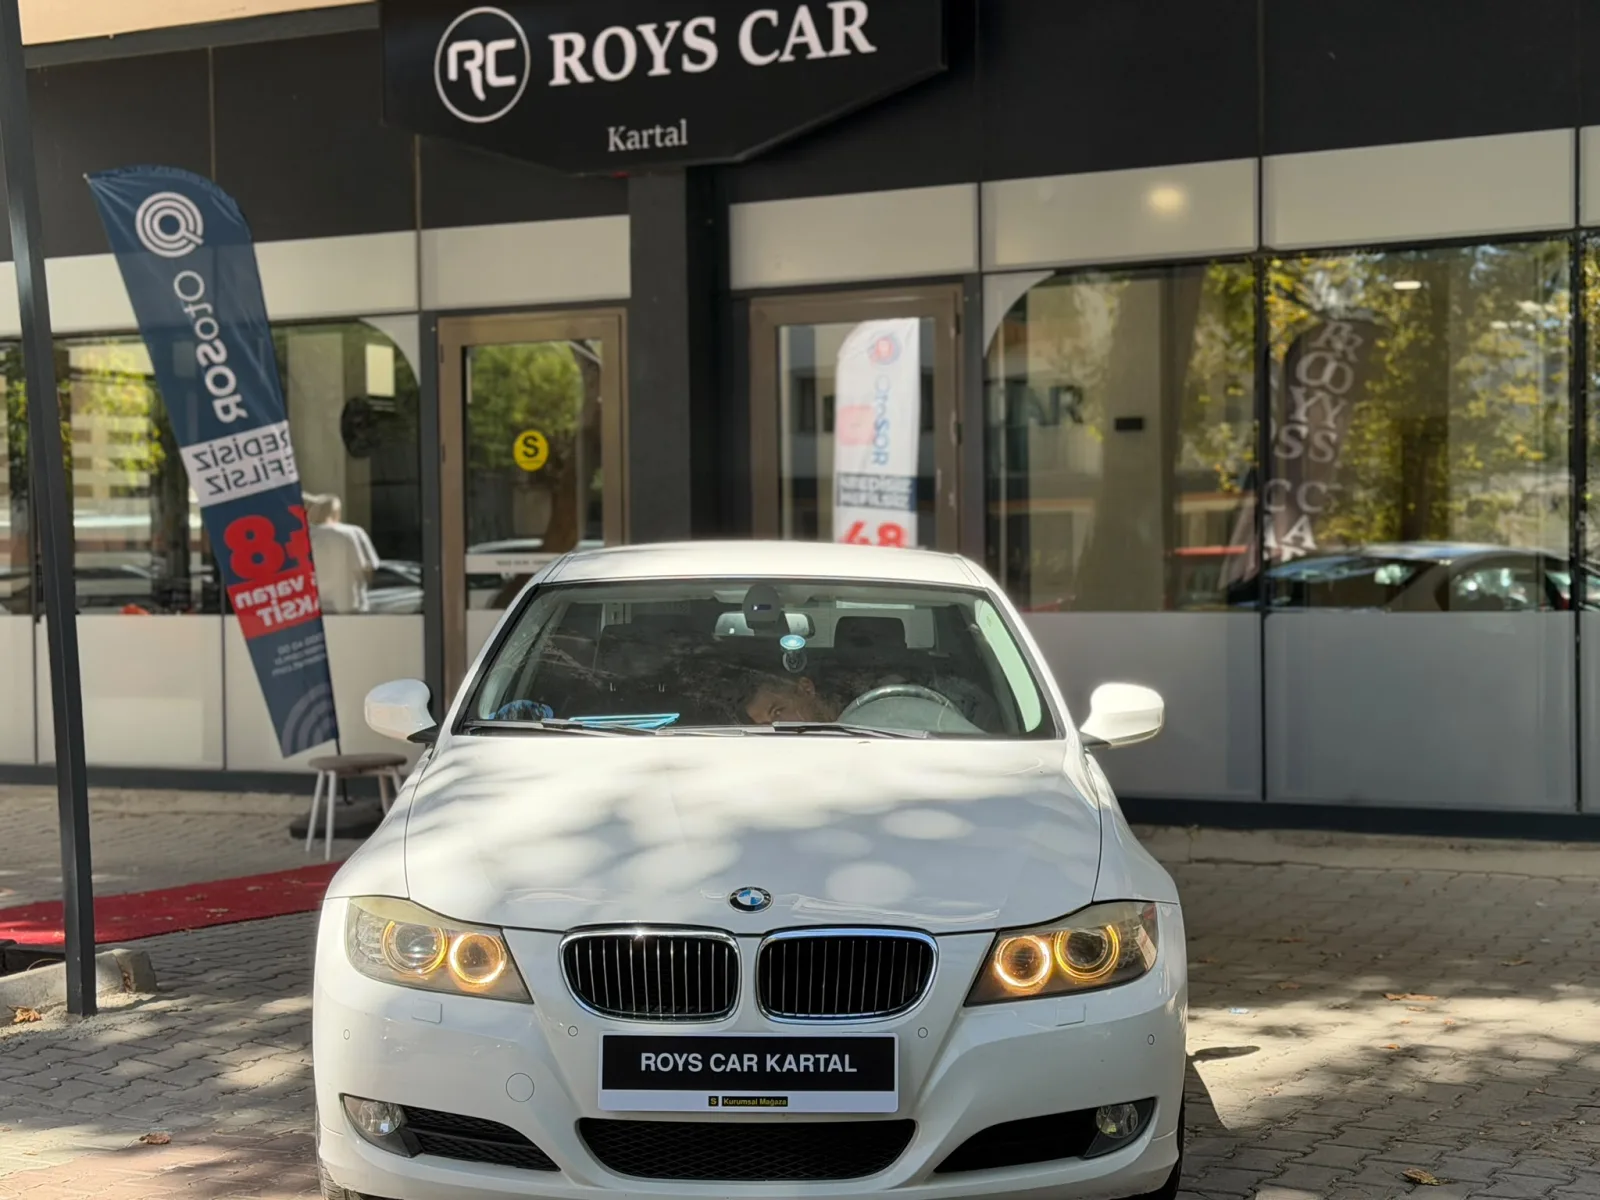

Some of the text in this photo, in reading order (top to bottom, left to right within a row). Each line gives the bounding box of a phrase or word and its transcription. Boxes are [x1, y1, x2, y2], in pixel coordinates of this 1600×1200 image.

[548, 0, 877, 86] ROYS CAR
[607, 119, 688, 152] Kartal
[523, 435, 540, 458] S
[640, 1052, 857, 1073] ROYS CAR KARTAL
[723, 1098, 758, 1106] Kurumsal
[759, 1098, 787, 1107] Mağaza
